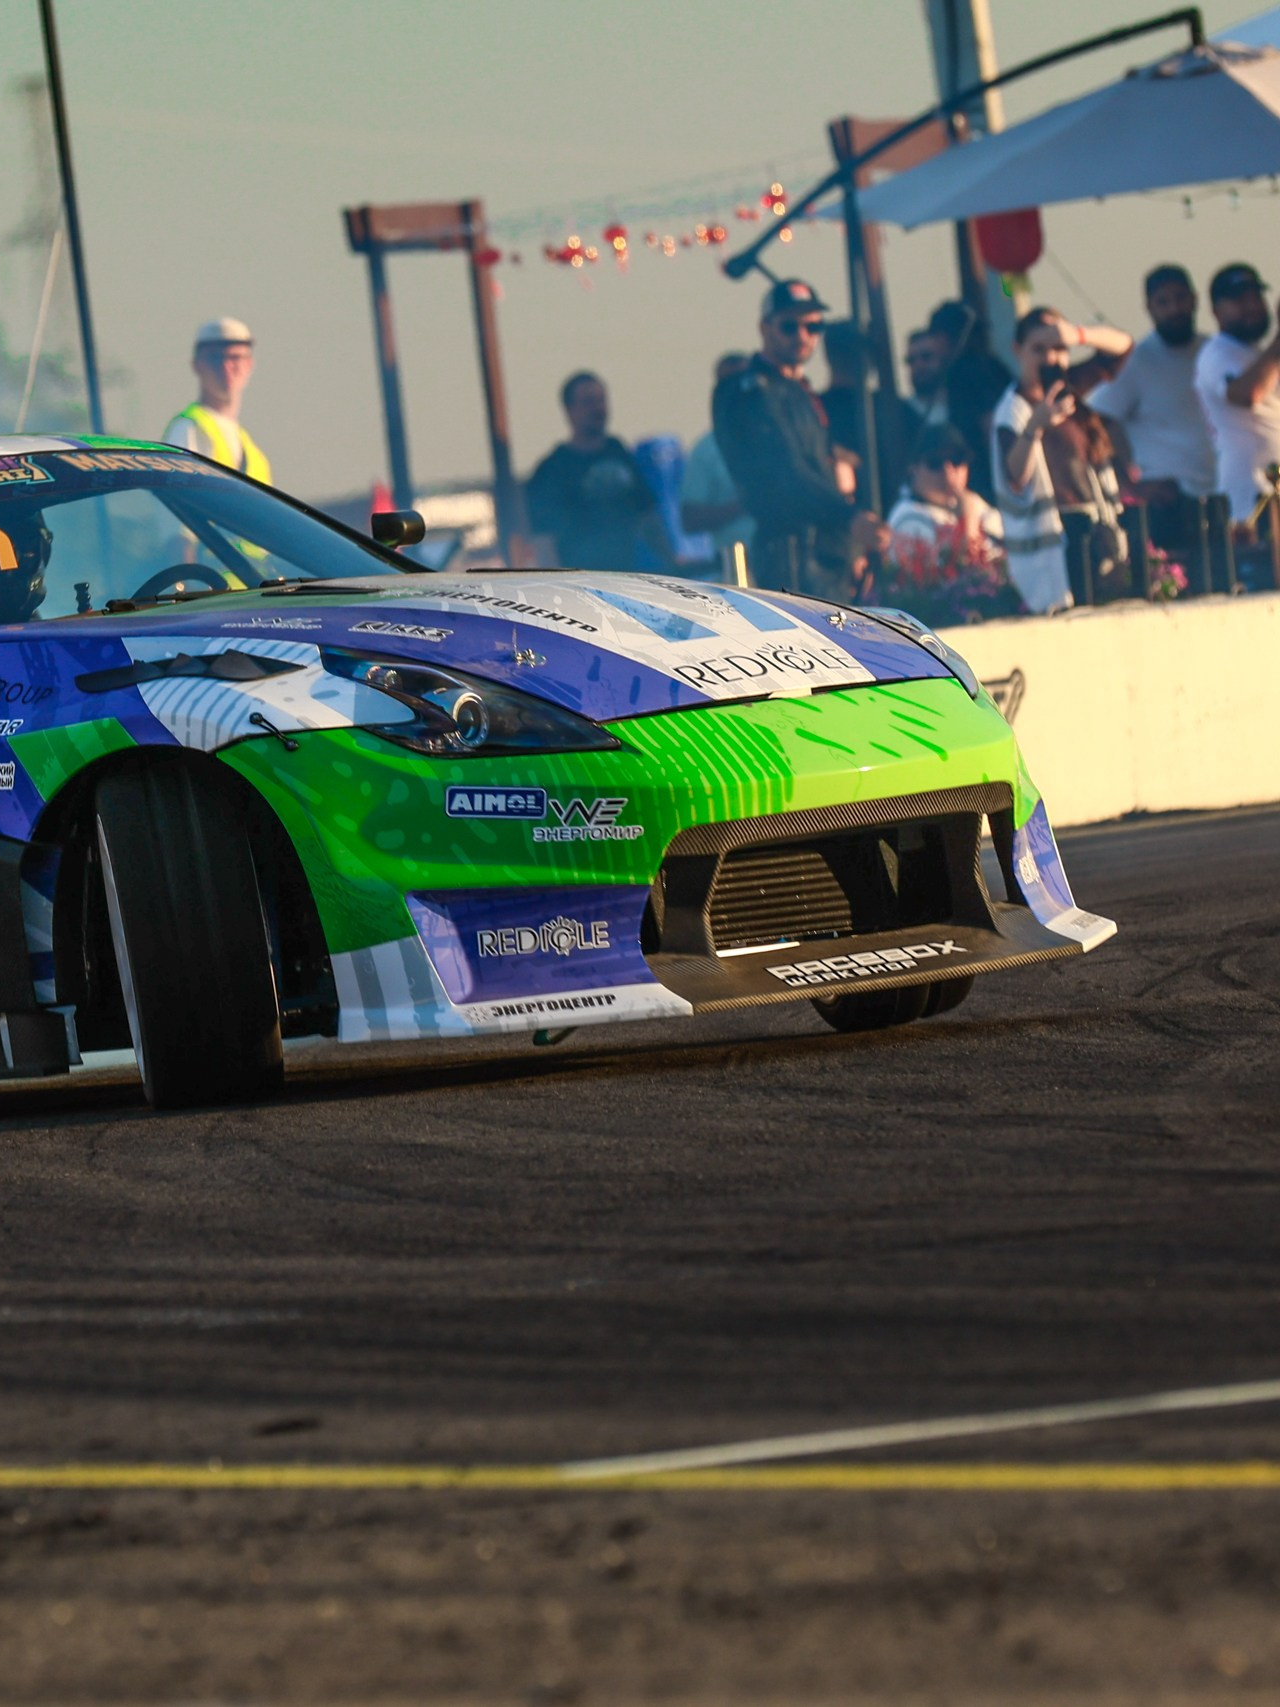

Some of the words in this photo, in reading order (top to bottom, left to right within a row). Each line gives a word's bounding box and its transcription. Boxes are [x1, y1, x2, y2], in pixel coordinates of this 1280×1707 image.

[450, 792, 543, 814] AIMOL
[533, 825, 644, 842] ЭНЕРГОМИР
[765, 939, 969, 980] RACEBOX
[785, 960, 918, 987] WORKSHOP
[492, 994, 617, 1017] ЭНЕРГОЦЕНТР
